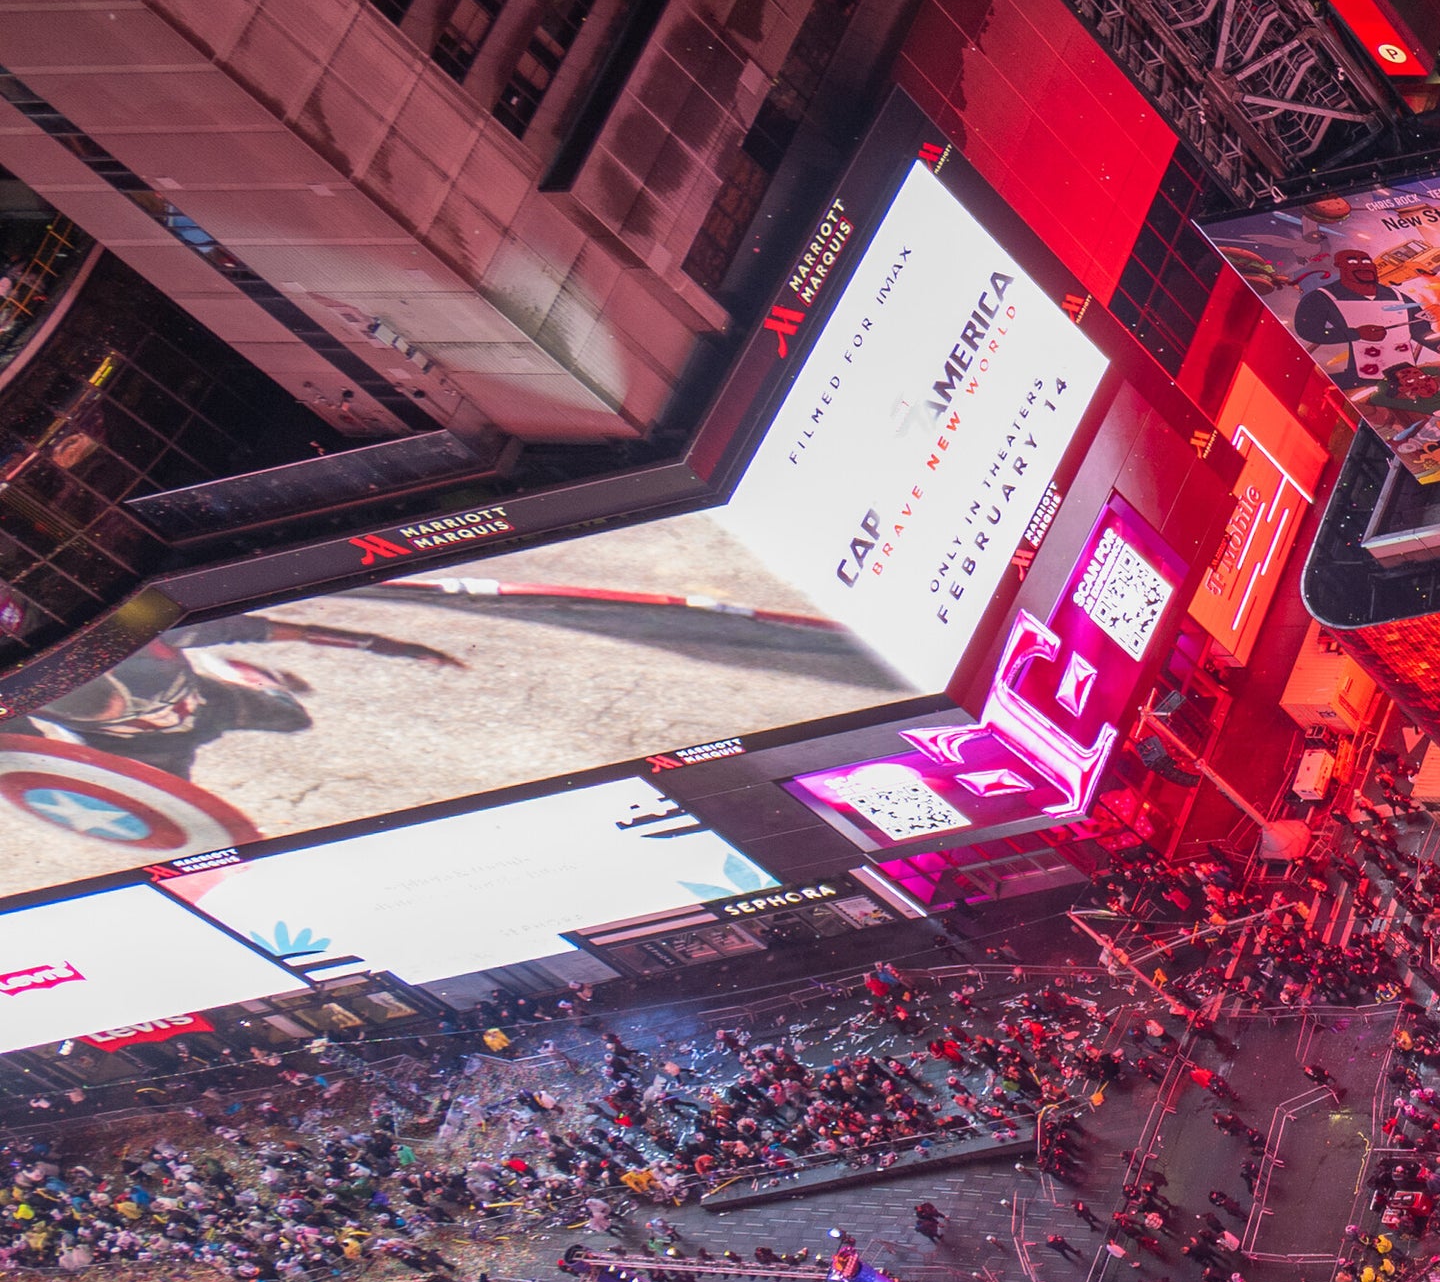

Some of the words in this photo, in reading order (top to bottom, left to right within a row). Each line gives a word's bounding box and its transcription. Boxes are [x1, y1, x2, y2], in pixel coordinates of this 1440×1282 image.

[1385, 47, 1400, 60] P
[933, 143, 952, 175] MARRIOTT
[1366, 196, 1394, 212] CHRIS
[1396, 193, 1420, 207] ROCK
[1383, 215, 1423, 232] New
[788, 197, 847, 293] MARRIOTT
[799, 218, 853, 304] MARQUIS
[1075, 293, 1092, 323] MARRIOTT
[788, 375, 841, 465] FILMED
[844, 317, 874, 363] FOR
[876, 246, 912, 305] IMAX
[923, 270, 1015, 422] AMERICA
[872, 485, 924, 576] BRAVE
[926, 411, 962, 471] NEW
[965, 305, 1017, 396] WORLD
[1202, 429, 1219, 459] MARRIOTT
[930, 535, 963, 593] ONLY
[964, 500, 982, 525] IN
[983, 377, 1044, 490] THEATERS
[937, 433, 1040, 625] FEBRUARY
[1044, 376, 1069, 414] 14
[399, 505, 508, 540] MARRIOTT
[1023, 480, 1057, 543] MARRIOTT
[1030, 493, 1062, 550] MARQUIS
[409, 518, 513, 551] MARQUIS
[1072, 566, 1099, 608] SCAN
[1097, 527, 1118, 565] FOR
[675, 738, 743, 758] MARRIOTT
[683, 747, 744, 765] MARQUIS
[172, 848, 238, 867] MARRIOTT
[181, 855, 242, 873] MARQUIS
[724, 884, 836, 916] SEPHORA
